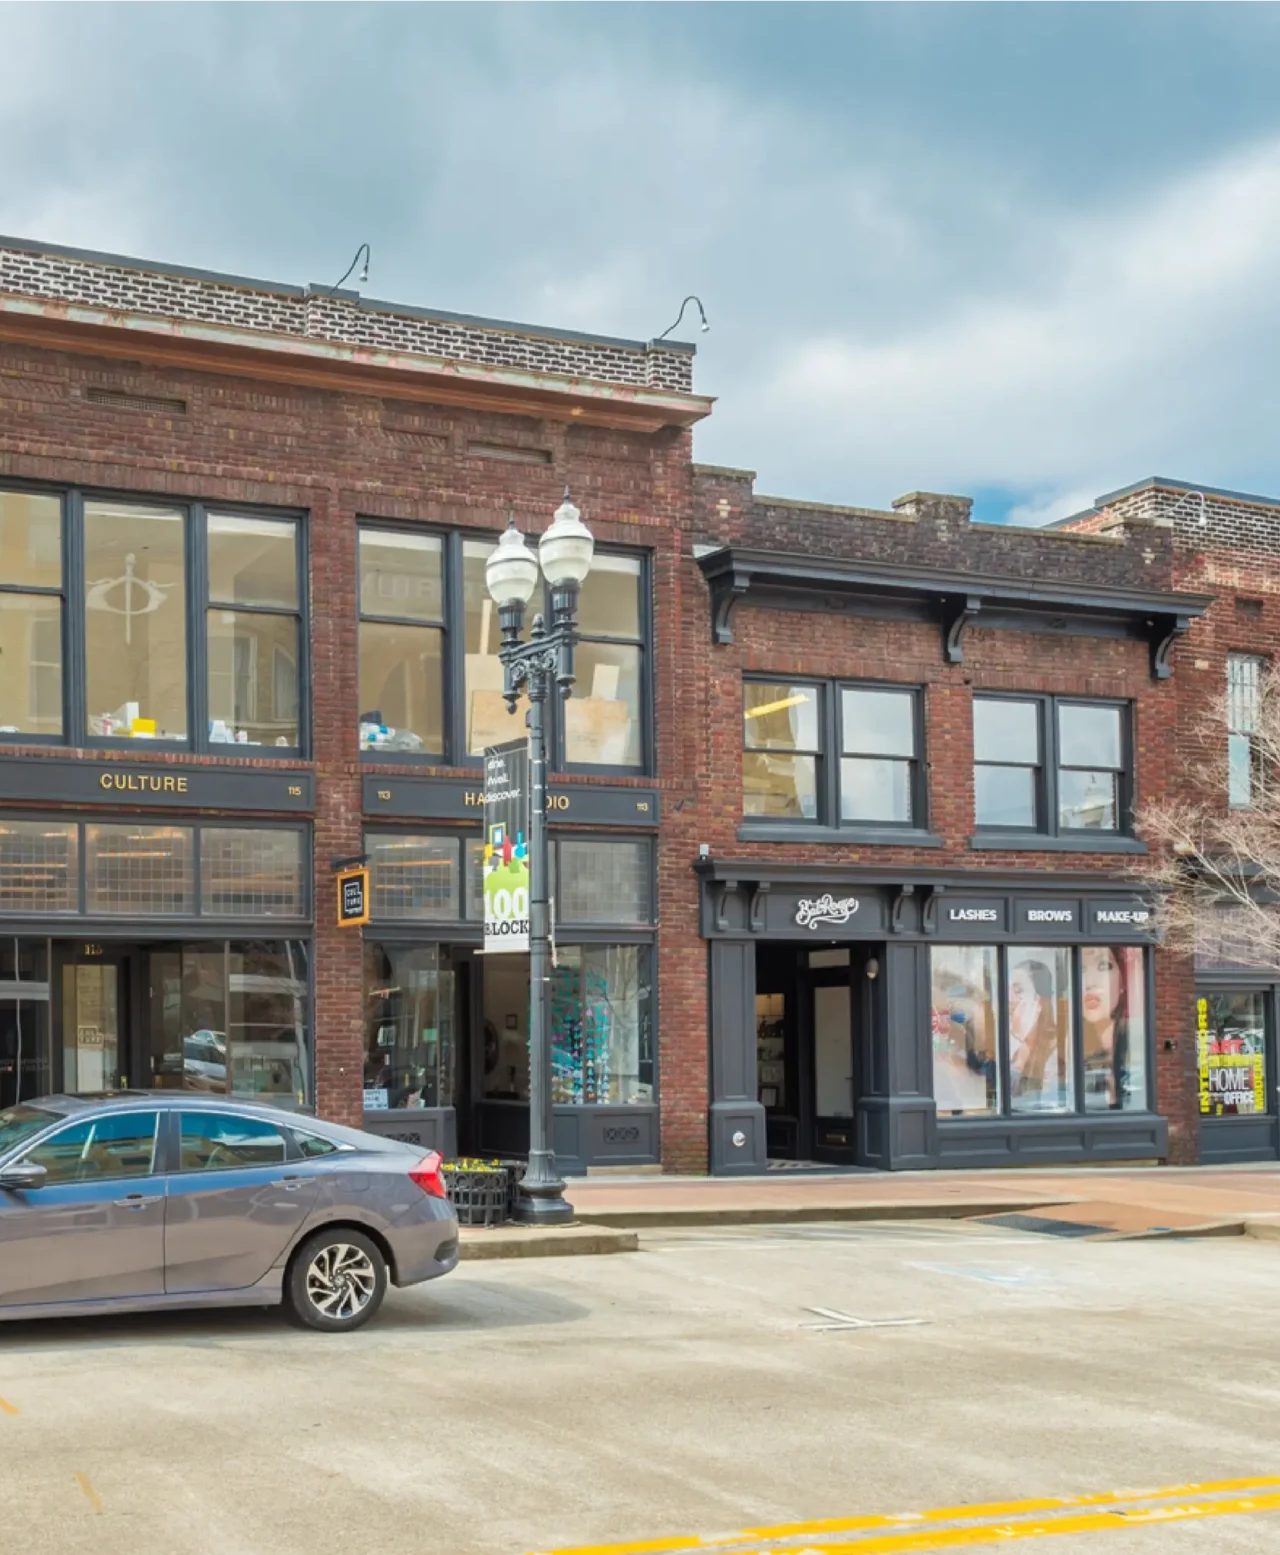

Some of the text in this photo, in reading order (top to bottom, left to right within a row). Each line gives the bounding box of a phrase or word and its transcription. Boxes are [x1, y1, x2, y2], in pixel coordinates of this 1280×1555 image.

[99, 773, 189, 793] CULTURE
[287, 785, 302, 796] 115
[377, 790, 391, 800] 113
[635, 802, 649, 812] 113
[483, 887, 529, 921] 100
[950, 908, 997, 922] LASHES
[1027, 909, 1073, 922] BROWS
[1097, 910, 1149, 924] MAKE-UP
[484, 919, 529, 936] BLOCK
[1196, 998, 1211, 1114] INTERIORS
[1208, 1068, 1250, 1092] HOME
[1223, 1091, 1255, 1105] OFFICE
